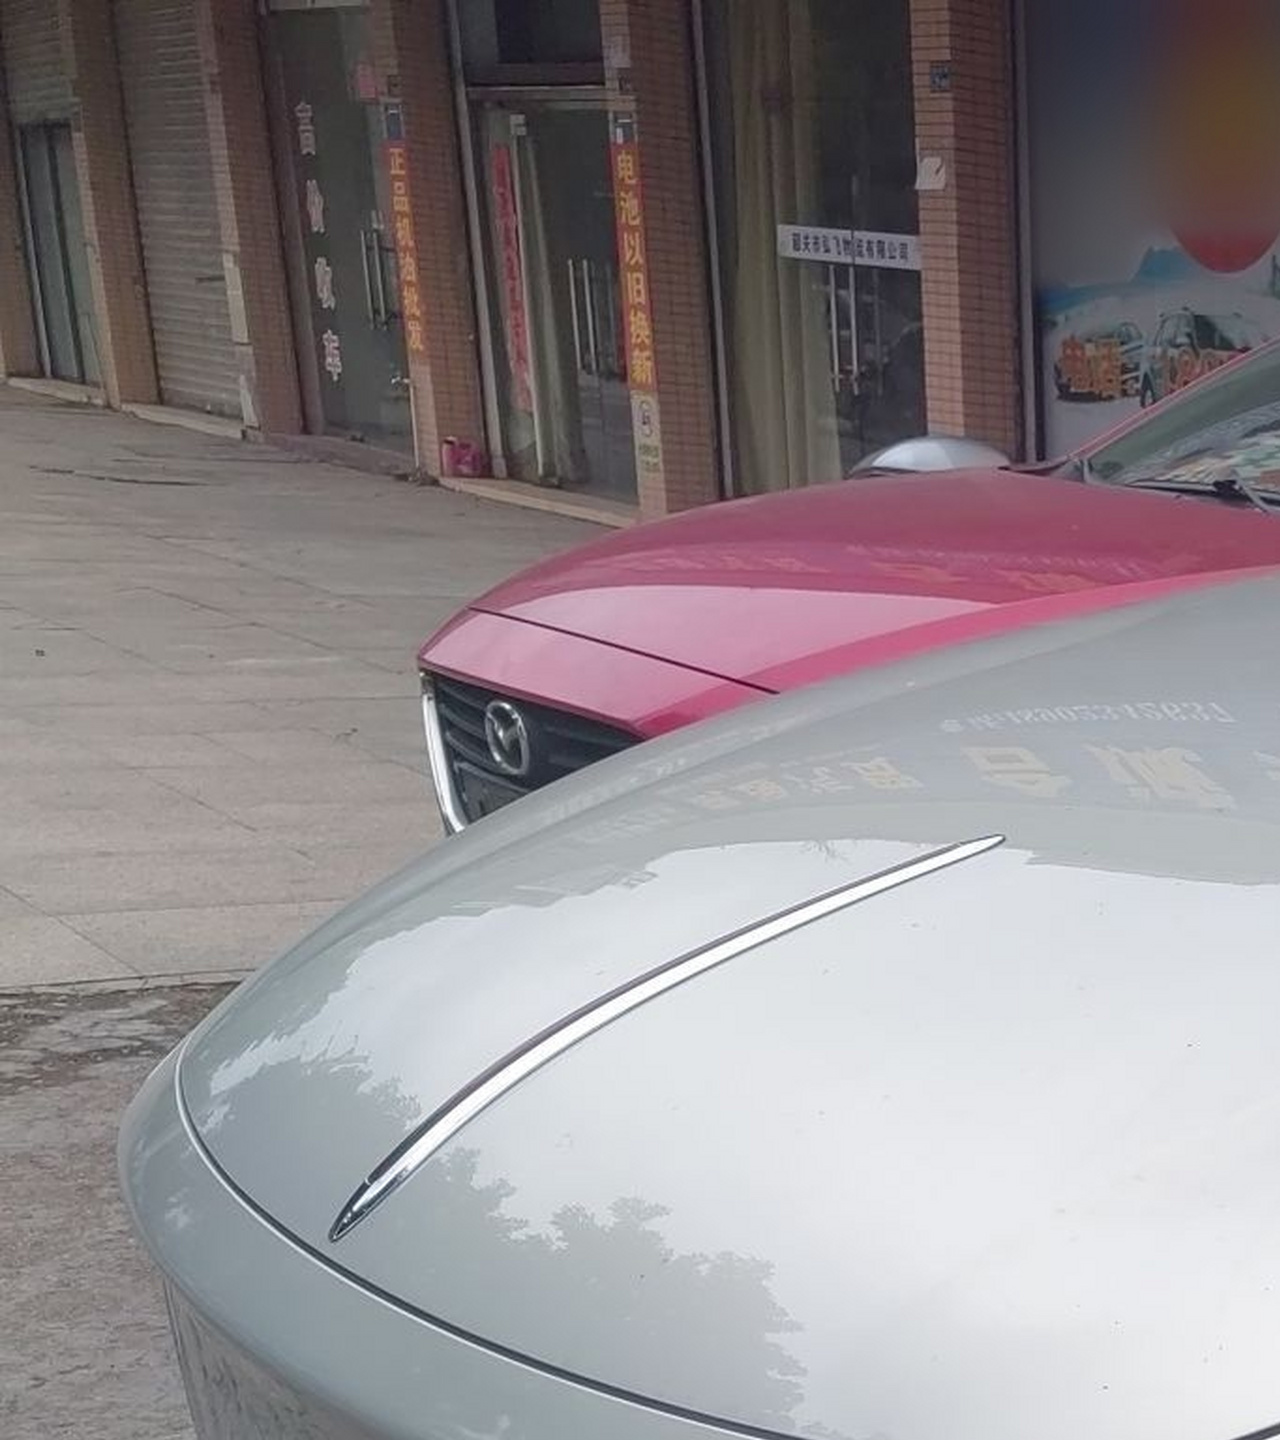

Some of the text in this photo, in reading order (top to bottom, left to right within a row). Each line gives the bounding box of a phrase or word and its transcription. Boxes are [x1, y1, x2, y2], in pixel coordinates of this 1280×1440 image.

[615, 148, 655, 385] 电池以旧换新
